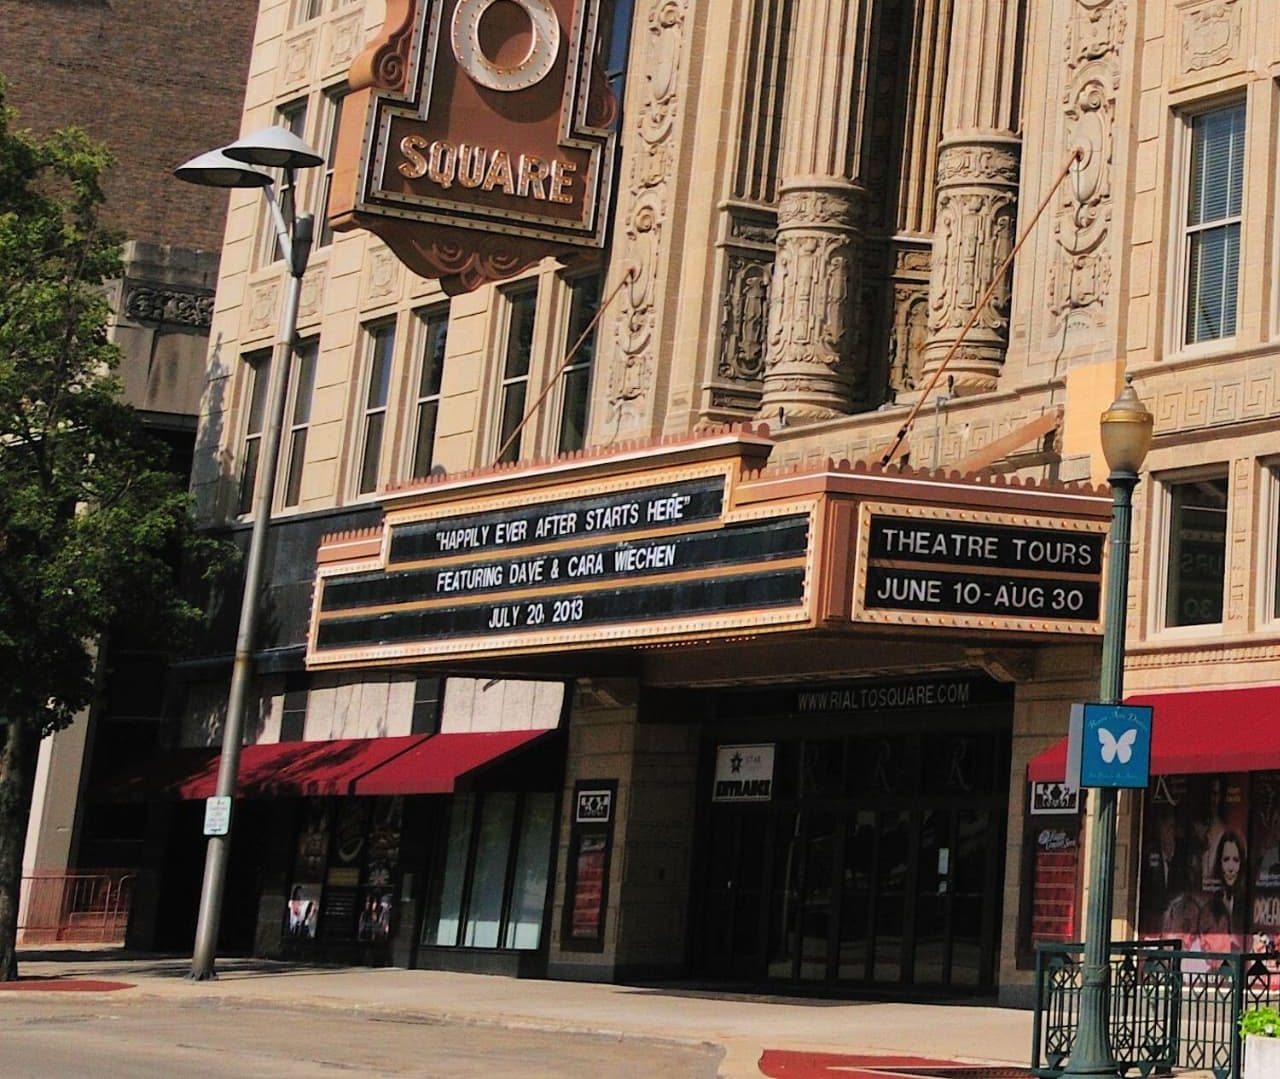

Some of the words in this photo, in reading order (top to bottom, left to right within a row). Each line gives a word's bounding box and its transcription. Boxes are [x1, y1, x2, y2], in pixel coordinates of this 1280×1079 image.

[398, 135, 577, 204] SQUARE
[436, 523, 490, 550] "HAPPILY
[495, 520, 527, 544] EVER
[535, 513, 577, 539] AFTER
[585, 503, 639, 531] STARTS
[882, 529, 999, 559] THEATRE
[1012, 539, 1092, 565] TOURS
[437, 566, 503, 592] FEATURING
[509, 560, 544, 585] DAVE
[551, 558, 560, 579] &
[567, 553, 604, 577] CARA
[614, 544, 676, 572] WIECHEN
[877, 577, 942, 603] JUNE
[1051, 589, 1083, 611] 30
[489, 606, 519, 628] JULY
[552, 599, 584, 621] 2013
[798, 683, 970, 711] WWW.RIALTOSQUARE.COM
